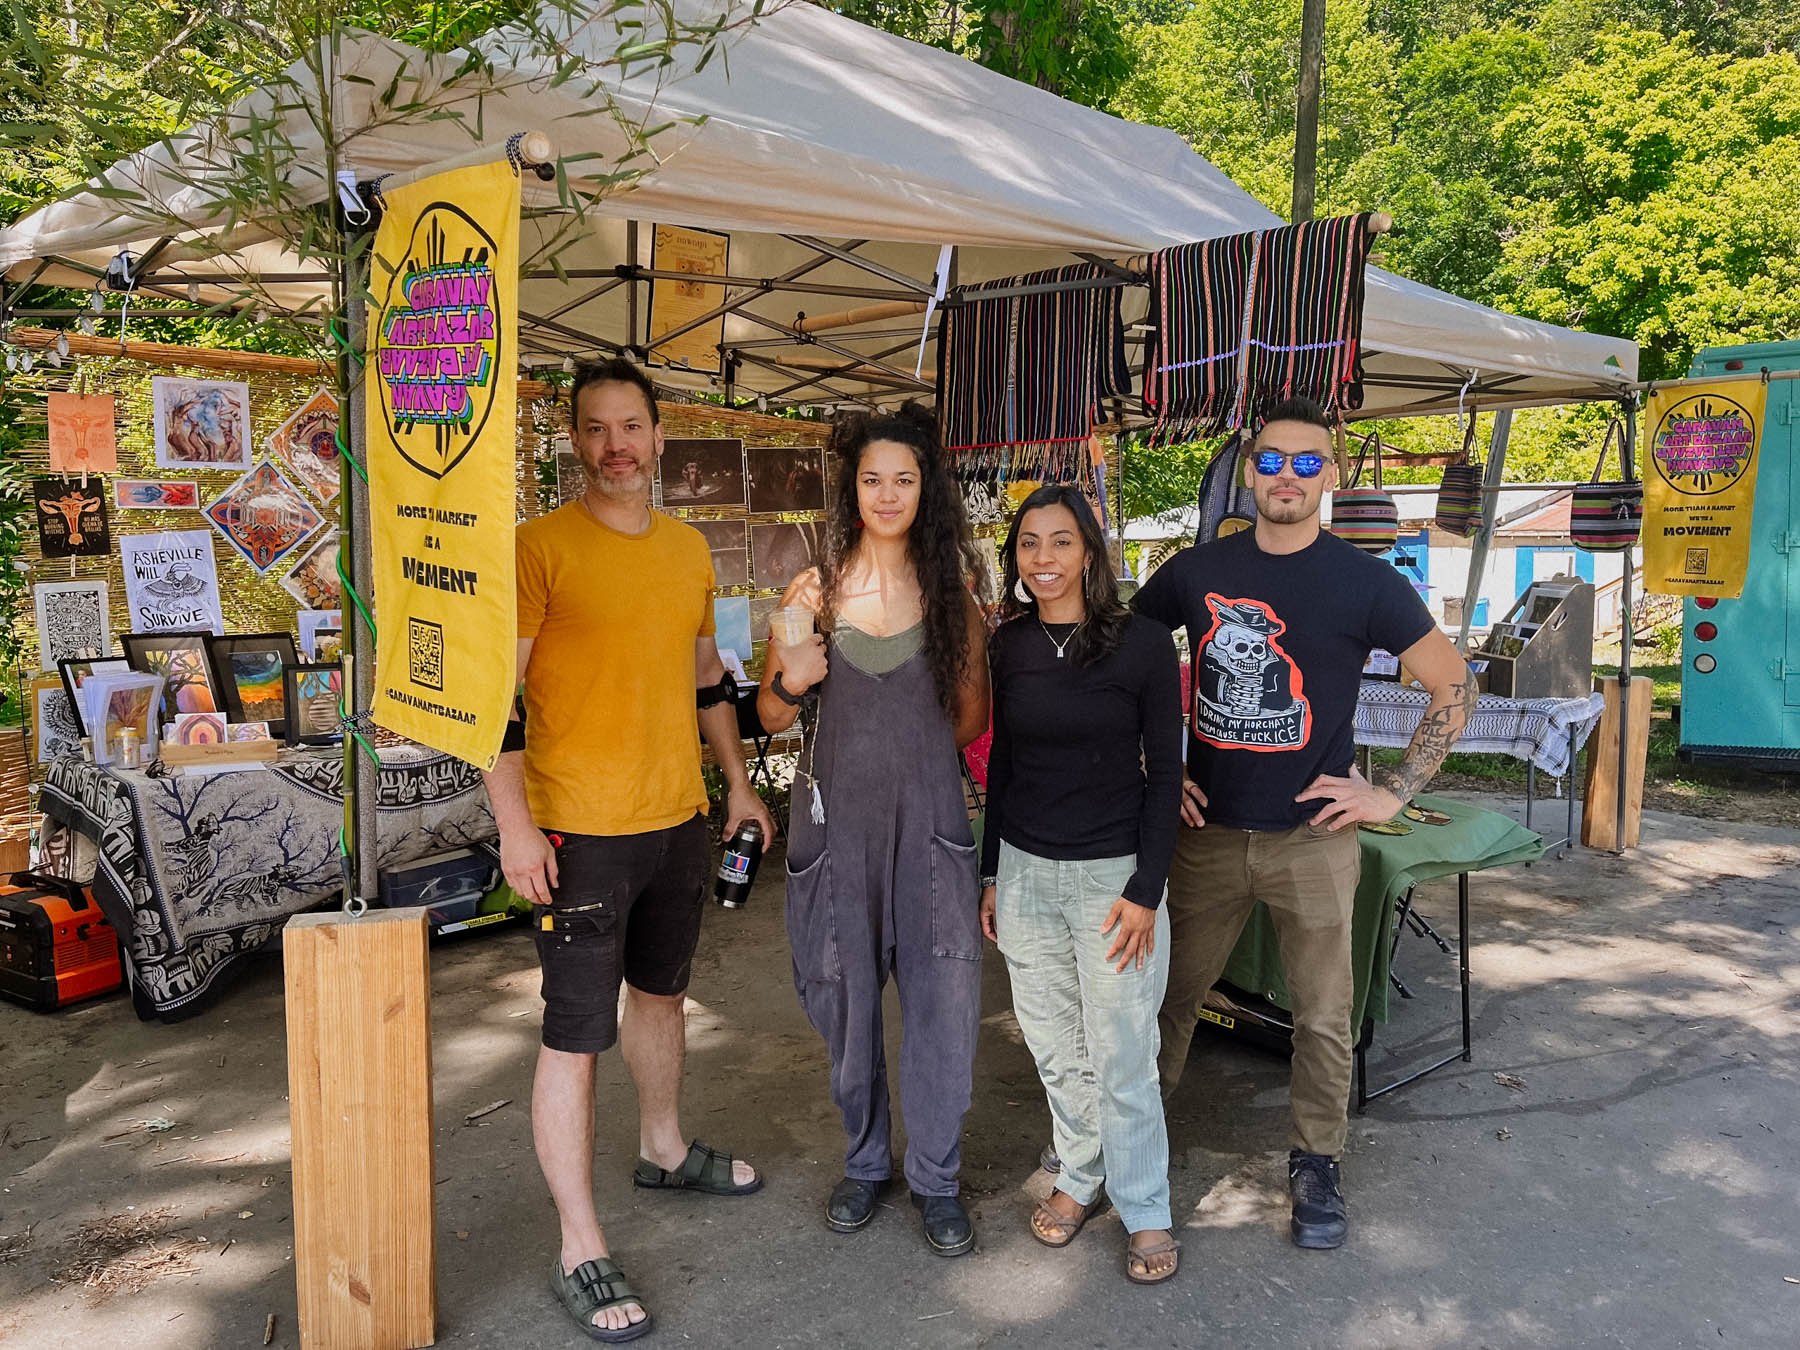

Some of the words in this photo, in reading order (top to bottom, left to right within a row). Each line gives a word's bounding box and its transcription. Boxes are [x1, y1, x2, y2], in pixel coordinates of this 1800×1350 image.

[1673, 418, 1745, 434] CARAVAN
[1663, 433, 1692, 447] ART
[1692, 430, 1753, 446] BAZAAR
[1656, 445, 1716, 459] BAZAAR
[1716, 443, 1748, 457] ART
[1666, 457, 1736, 473] CARAVAN
[397, 504, 428, 520] MORE
[435, 508, 478, 528] MARKET
[1663, 526, 1732, 537] MOVEMENT
[133, 548, 204, 566] ASHEVILLE
[135, 565, 161, 580] WILL
[1203, 704, 1226, 728] DRINK
[1228, 719, 1243, 730] MY
[1244, 716, 1295, 731] HORCHATA
[1216, 730, 1239, 740] CAUSE
[1243, 731, 1273, 743] FUCK
[1274, 725, 1298, 744] ICE
